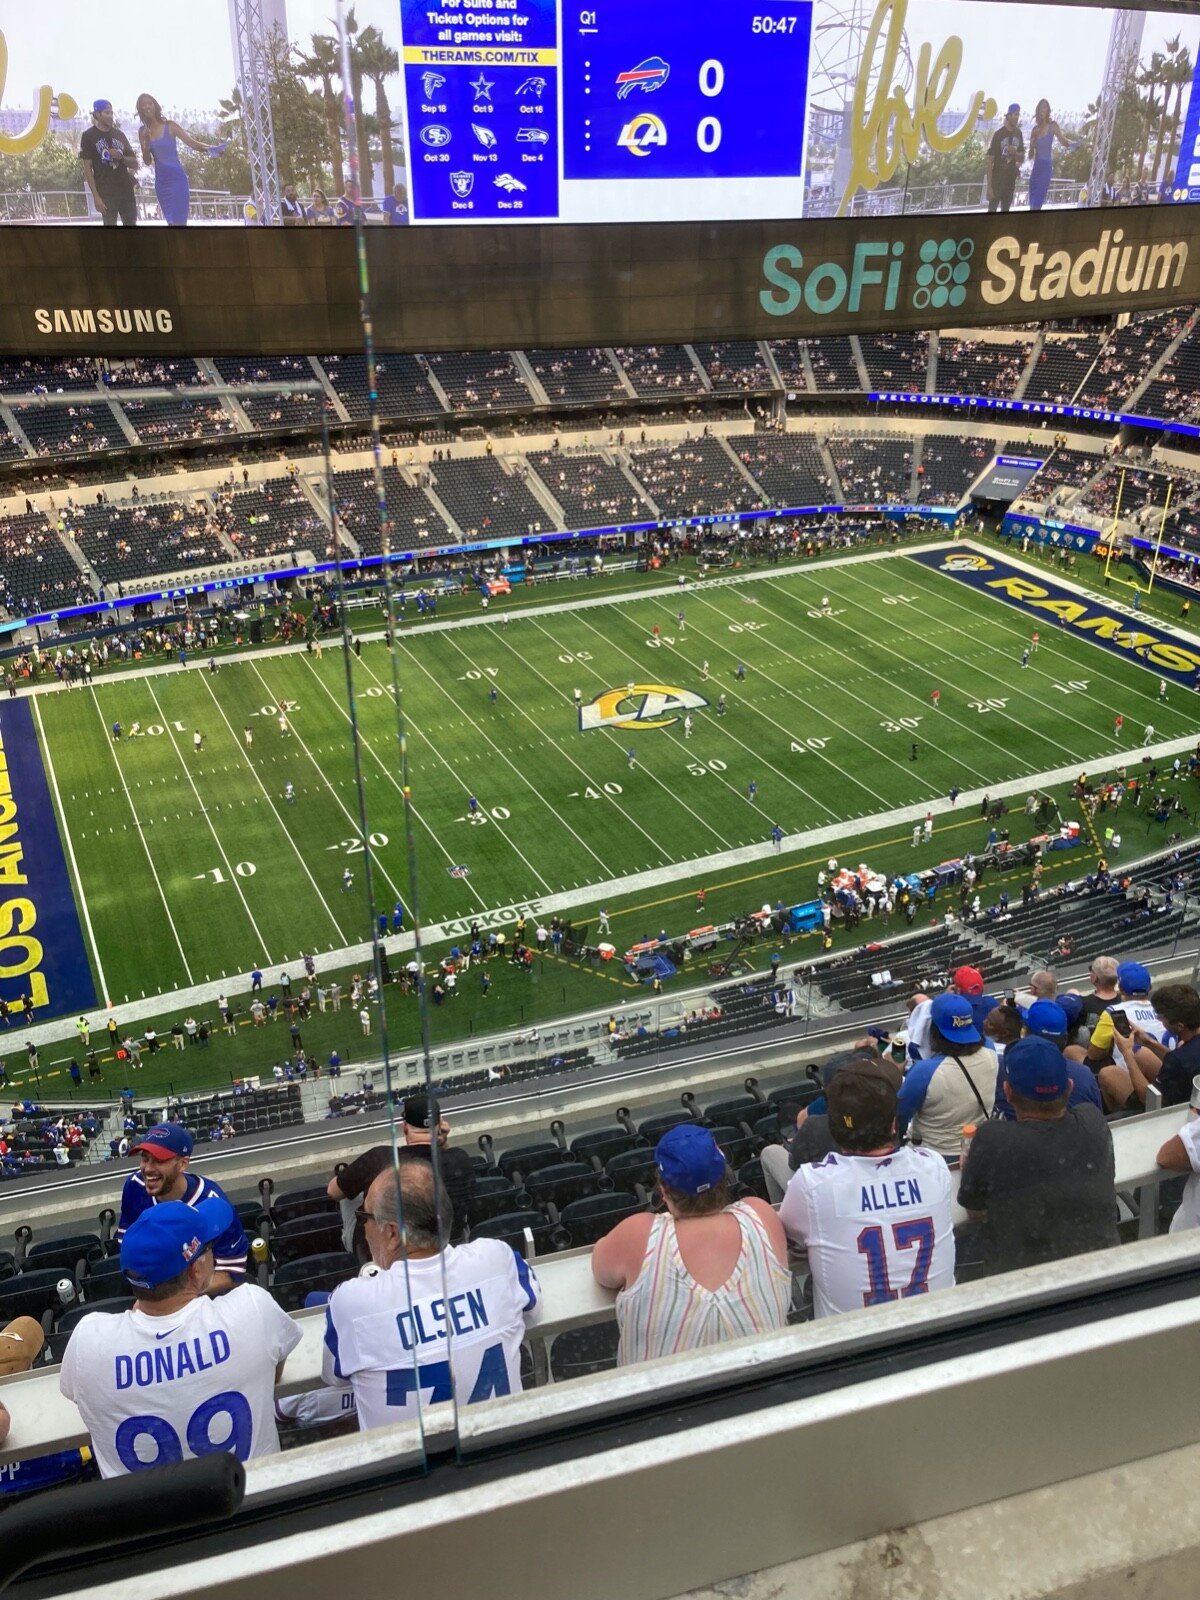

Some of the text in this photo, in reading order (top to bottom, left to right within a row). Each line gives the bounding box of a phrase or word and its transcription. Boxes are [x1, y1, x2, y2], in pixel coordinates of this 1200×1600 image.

[426, 12, 529, 27] Ticket Options for
[580, 11, 596, 25] Q1
[752, 16, 797, 34] 50:47
[438, 29, 523, 43] all games visit:
[422, 50, 539, 63] THERAMS.COM/TIX
[698, 58, 724, 97] 0
[421, 105, 447, 114] Sep 18
[473, 105, 494, 113] Oct 9
[696, 116, 722, 153] 0
[424, 154, 450, 162] Oct 30
[473, 154, 498, 162] Nov 13
[522, 154, 544, 162] Dec 4
[452, 201, 474, 209] Dec 8
[497, 201, 523, 209] Dec 25
[759, 228, 1189, 316] SoFi Stadium
[35, 308, 173, 334] SAMSUNG
[878, 394, 1122, 422] WELCOME TO THE RAMS HOUSE
[657, 515, 740, 528] RAMS HOUSE
[161, 575, 265, 599] RAMS HOUSE
[690, 576, 749, 589] KICKOFF
[1082, 591, 1176, 632] END RACISM
[984, 577, 1200, 672] RAMS
[558, 651, 593, 664] 50
[466, 667, 499, 680] 40
[1050, 679, 1087, 695] 10
[967, 697, 1007, 714] 20
[147, 719, 187, 736] 10
[879, 715, 920, 733] 30
[790, 736, 826, 755] 40
[686, 758, 728, 777] 50
[576, 781, 624, 800] 40
[470, 805, 511, 826] 30
[344, 832, 389, 855] 20
[208, 861, 257, 885] 10
[440, 900, 544, 937] KICKOFF
[861, 1178, 922, 1212] ALLEN
[856, 1216, 935, 1308] 17
[396, 1288, 489, 1351] OLSEN
[115, 1329, 231, 1391] DONALD
